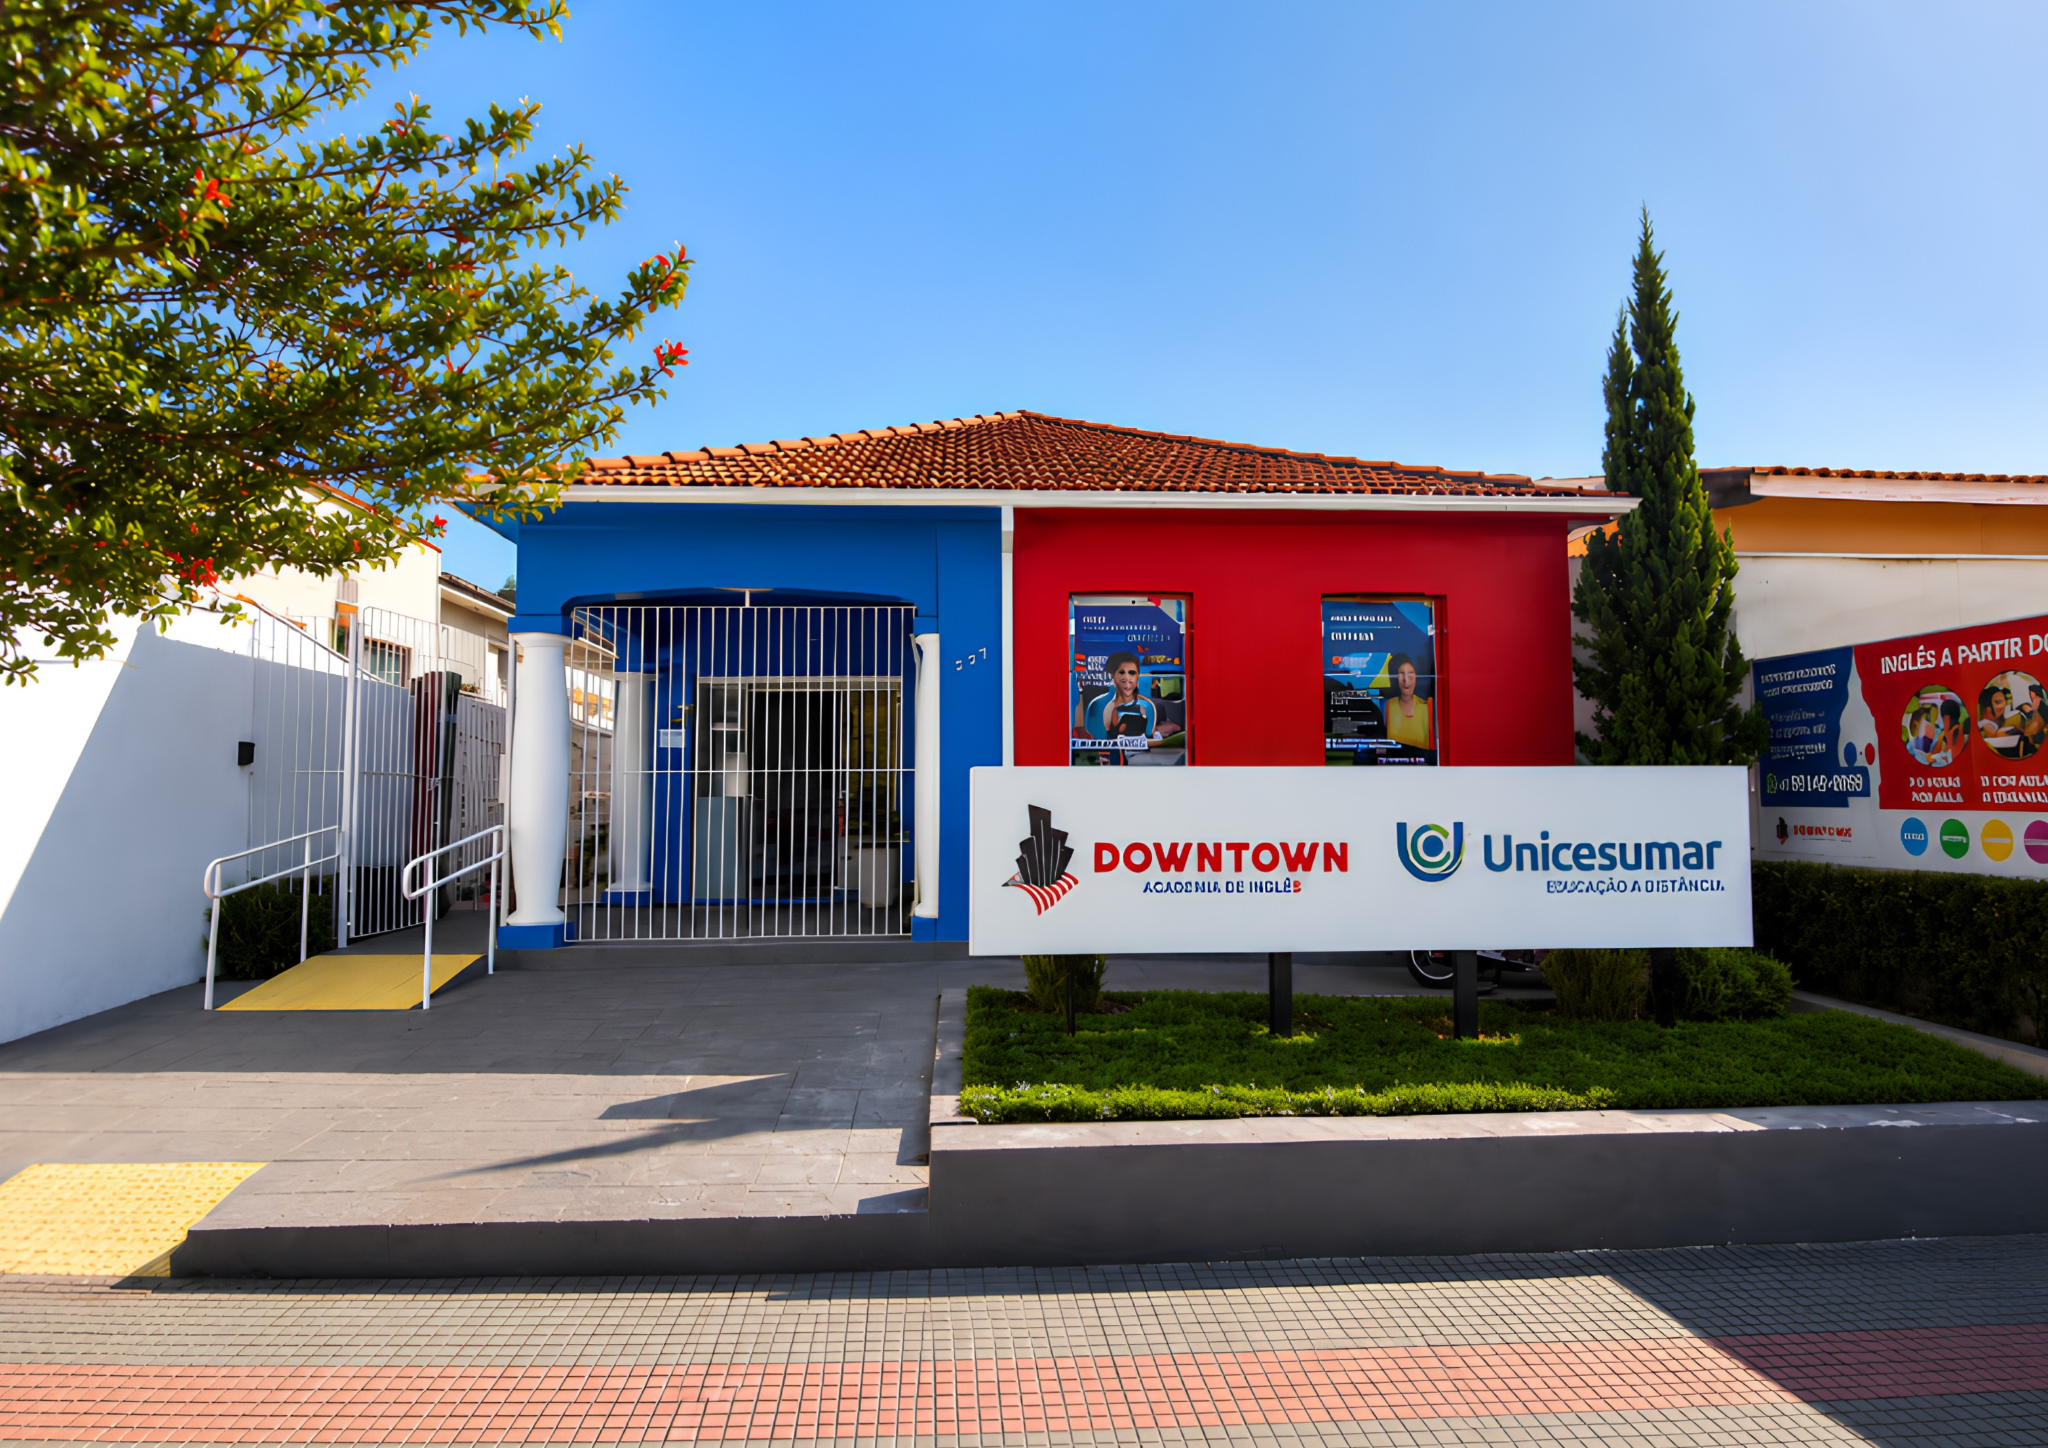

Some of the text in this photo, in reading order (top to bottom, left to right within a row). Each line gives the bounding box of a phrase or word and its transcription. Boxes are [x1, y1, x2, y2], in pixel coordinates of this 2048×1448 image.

[1940, 647, 1953, 667] A
[1958, 637, 2023, 665] PARTIR
[1094, 842, 1348, 873] DOWNTOWN
[1484, 831, 1723, 873] Unicesumar
